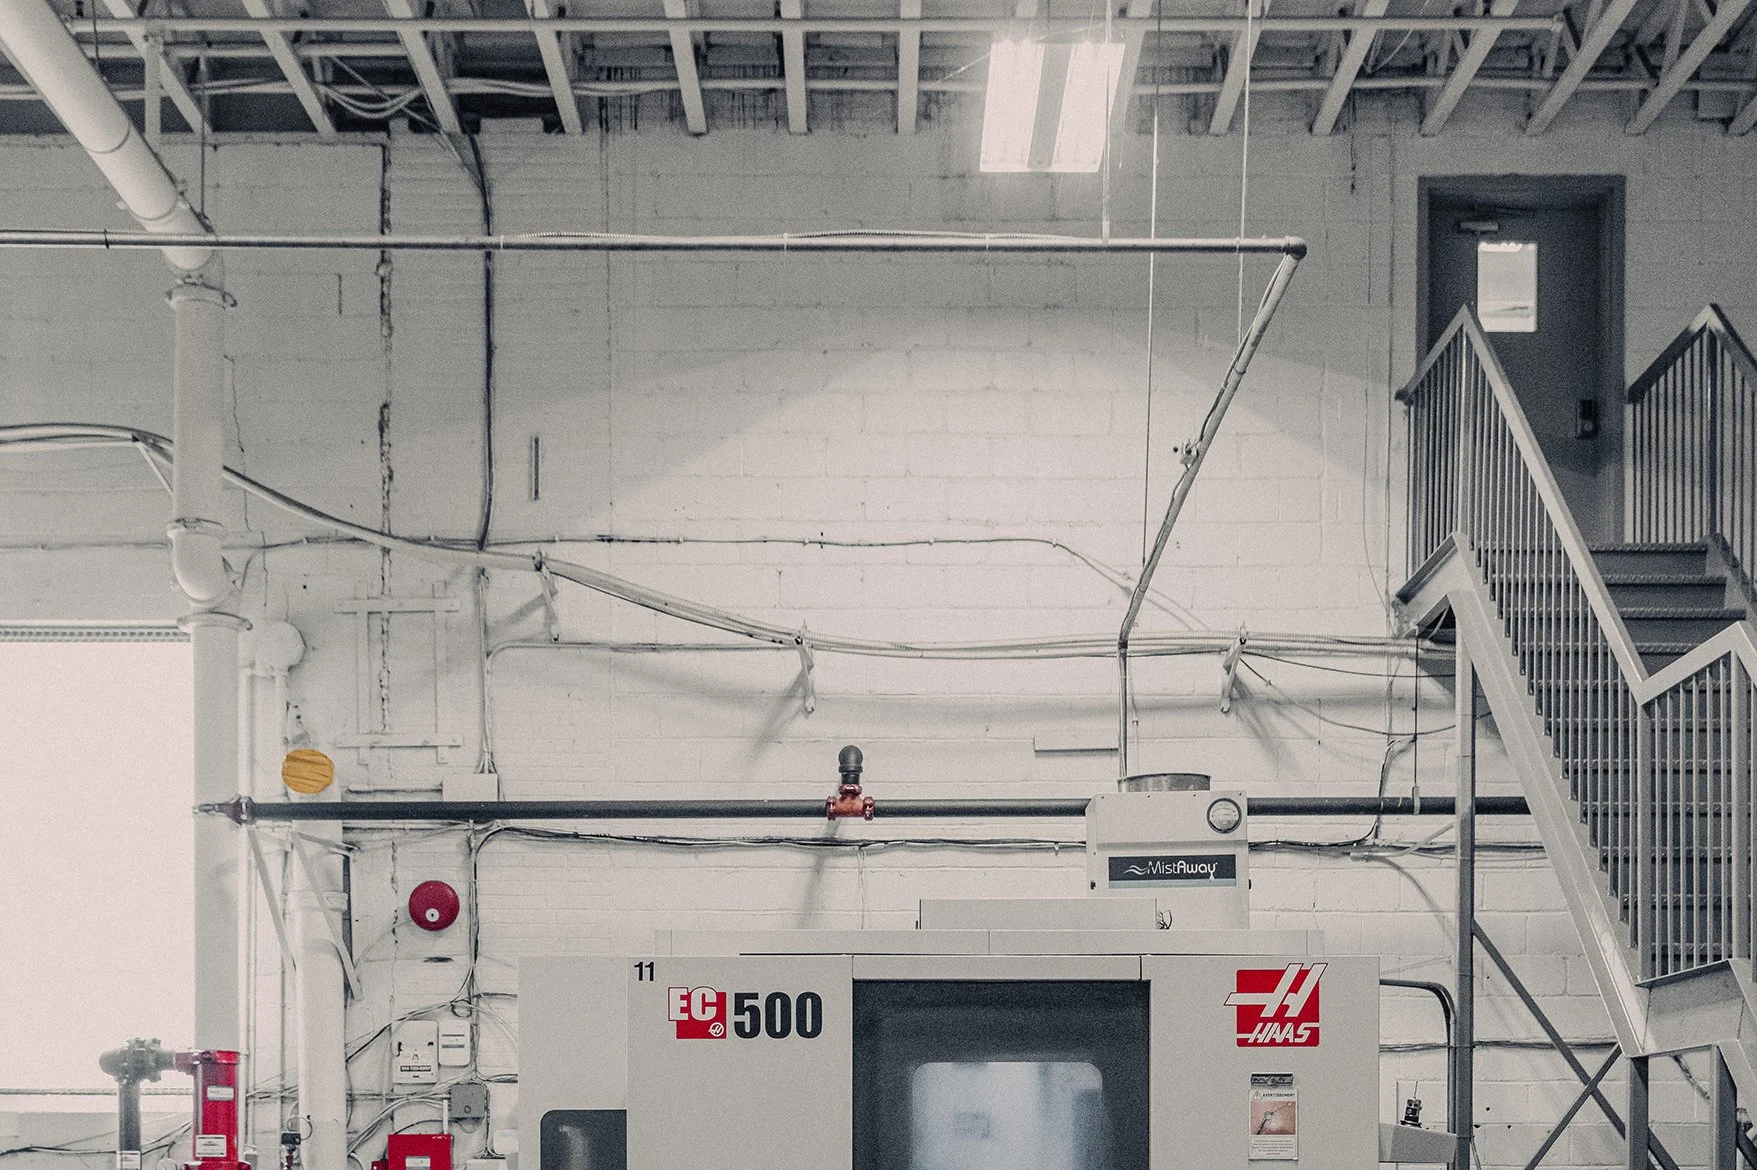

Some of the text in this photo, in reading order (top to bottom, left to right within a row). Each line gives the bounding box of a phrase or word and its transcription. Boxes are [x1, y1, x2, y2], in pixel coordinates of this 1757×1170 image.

[1147, 860, 1216, 879] MistAway
[634, 961, 655, 981] 11
[668, 986, 822, 1039] EC 500
[1238, 1022, 1319, 1043] HAAS
